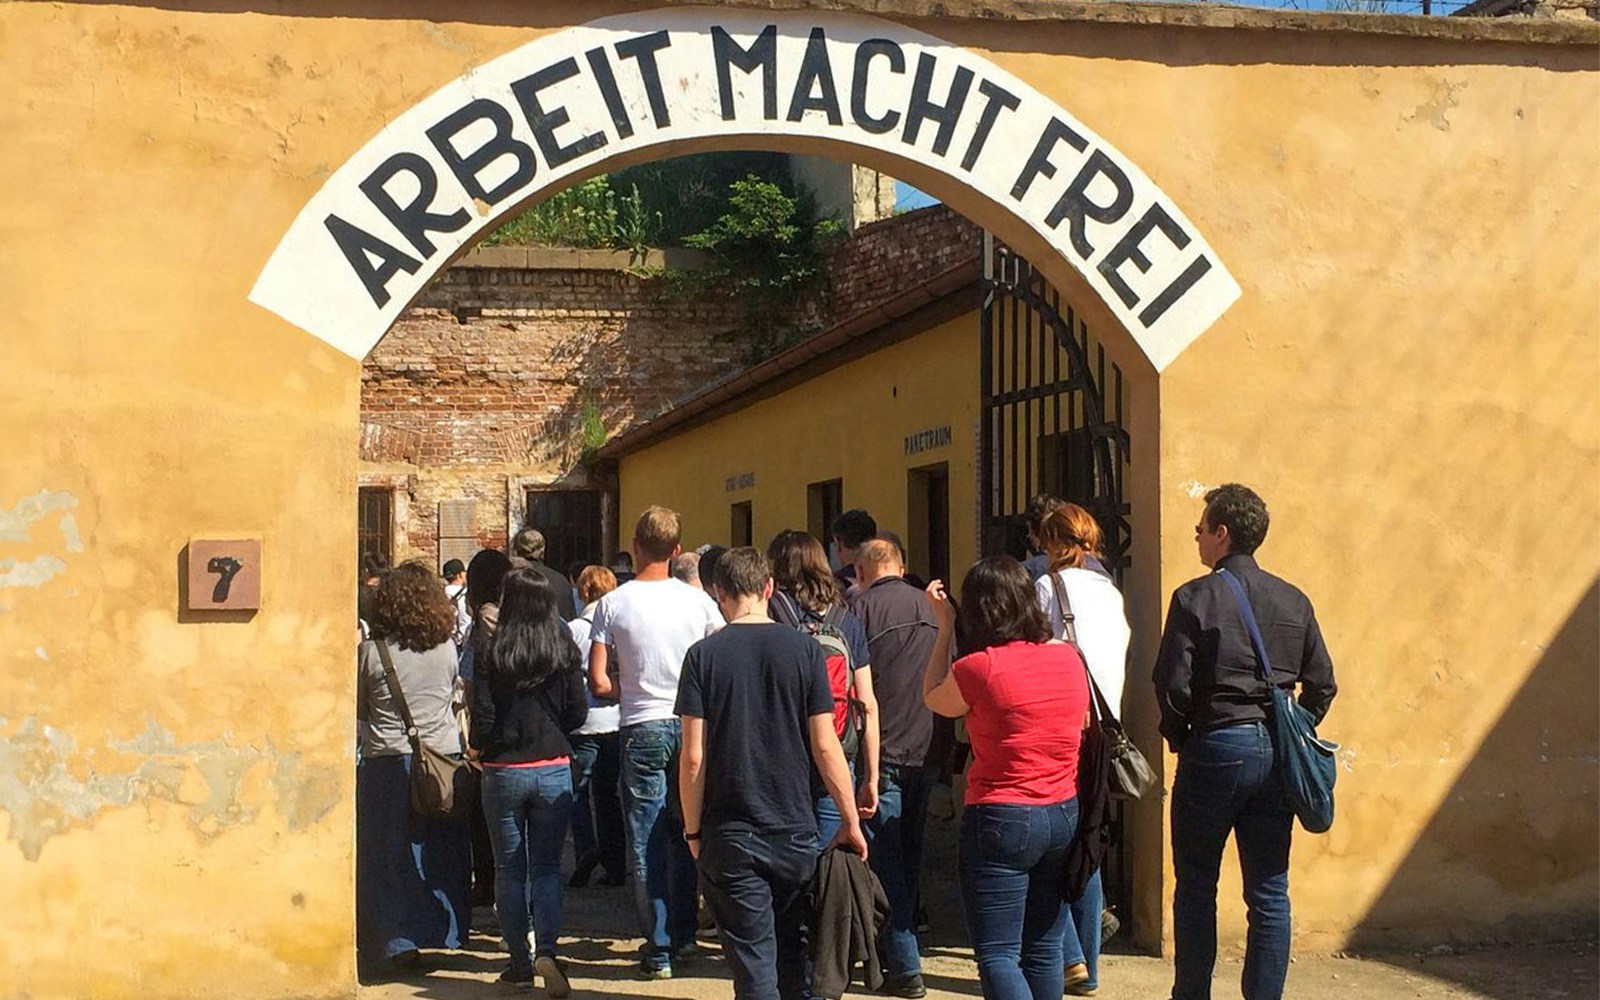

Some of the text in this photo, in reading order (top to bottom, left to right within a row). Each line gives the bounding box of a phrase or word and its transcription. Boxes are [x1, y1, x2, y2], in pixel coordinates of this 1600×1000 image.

[324, 25, 1212, 329] ARBEIT MACHT FREI
[904, 426, 952, 456] PAKETRAUM
[207, 556, 244, 603] 7
